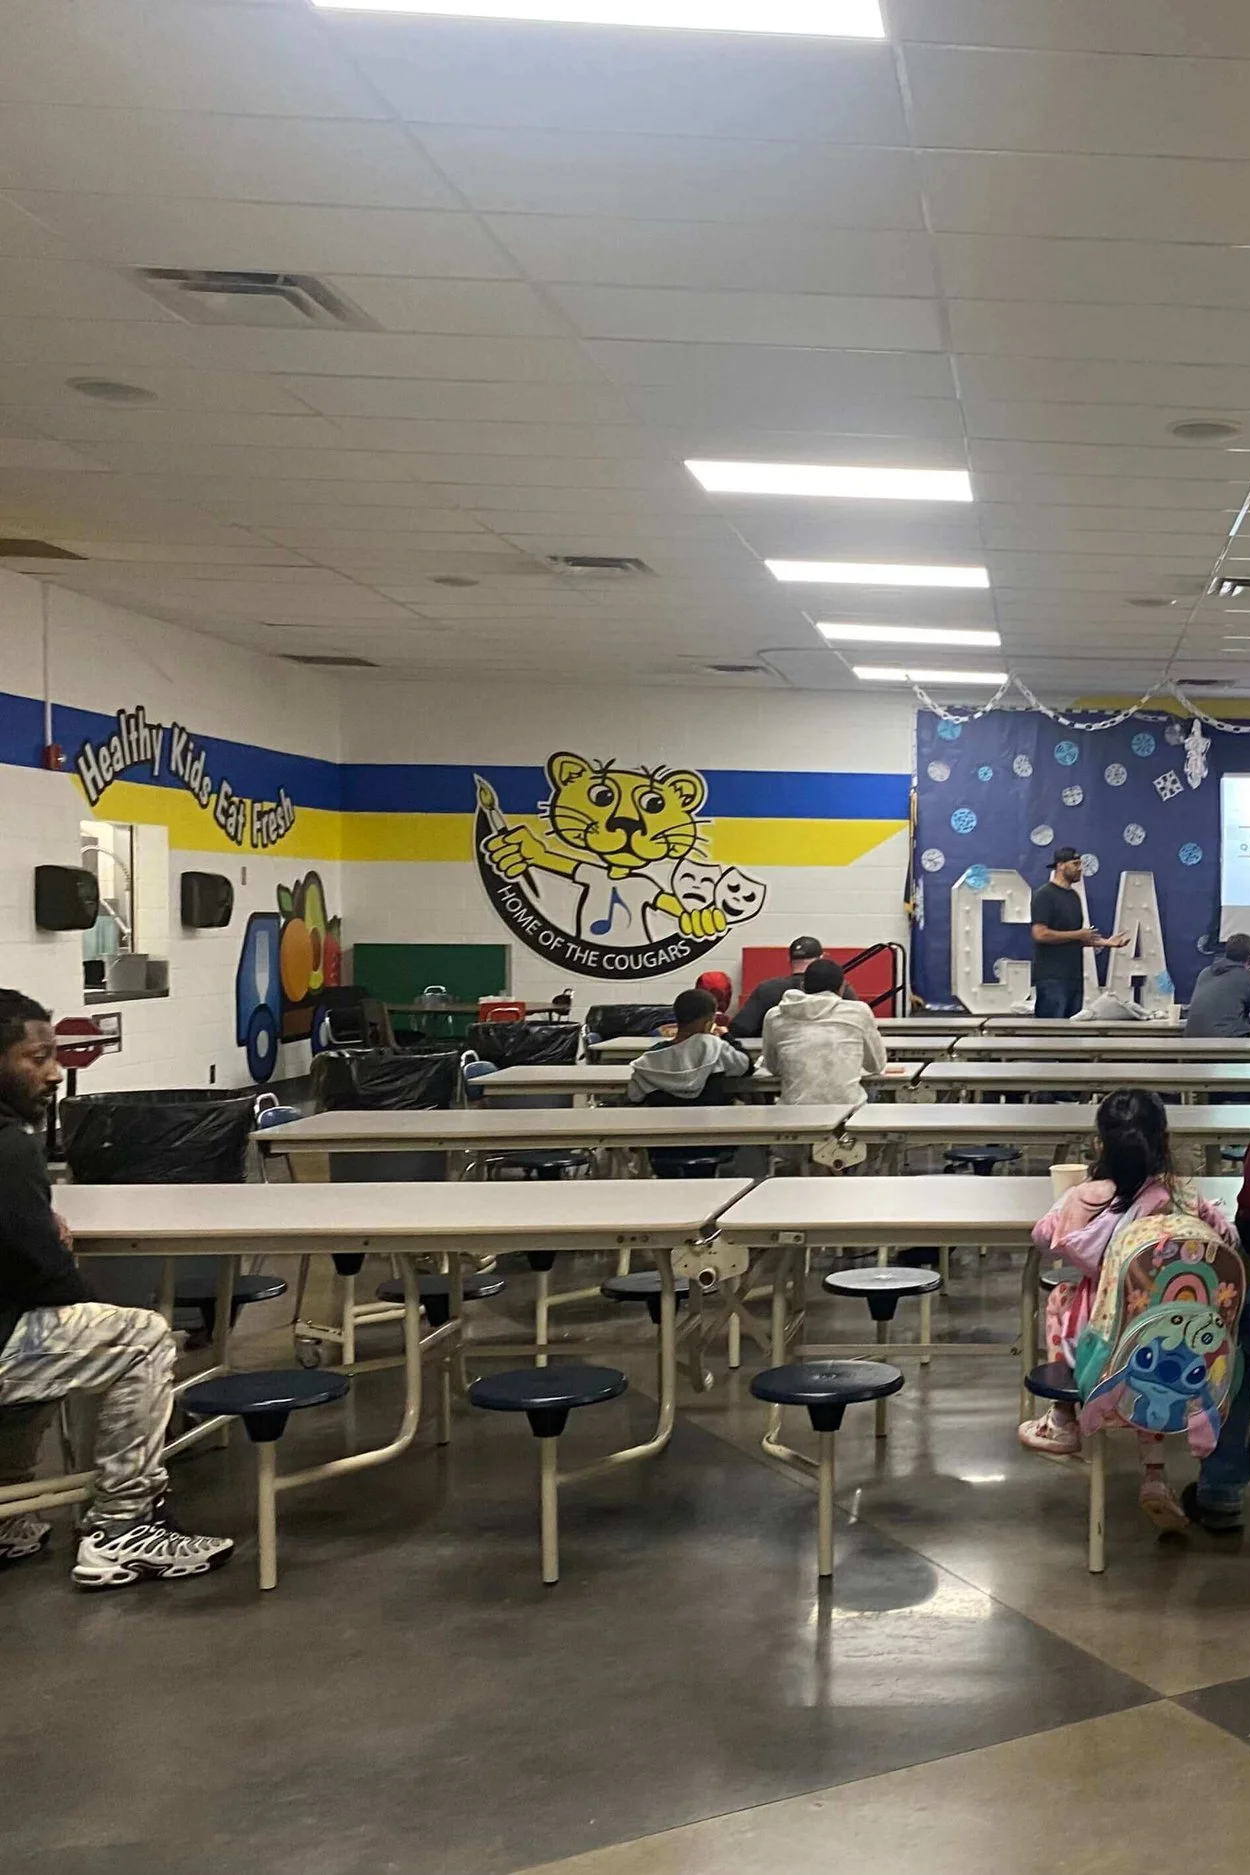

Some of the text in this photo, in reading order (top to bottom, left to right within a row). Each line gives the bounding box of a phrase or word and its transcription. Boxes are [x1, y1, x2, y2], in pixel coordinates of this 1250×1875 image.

[79, 706, 295, 849] Healthy Kids Eat Fresh
[497, 885, 691, 970] HOME OF THE COUGARS
